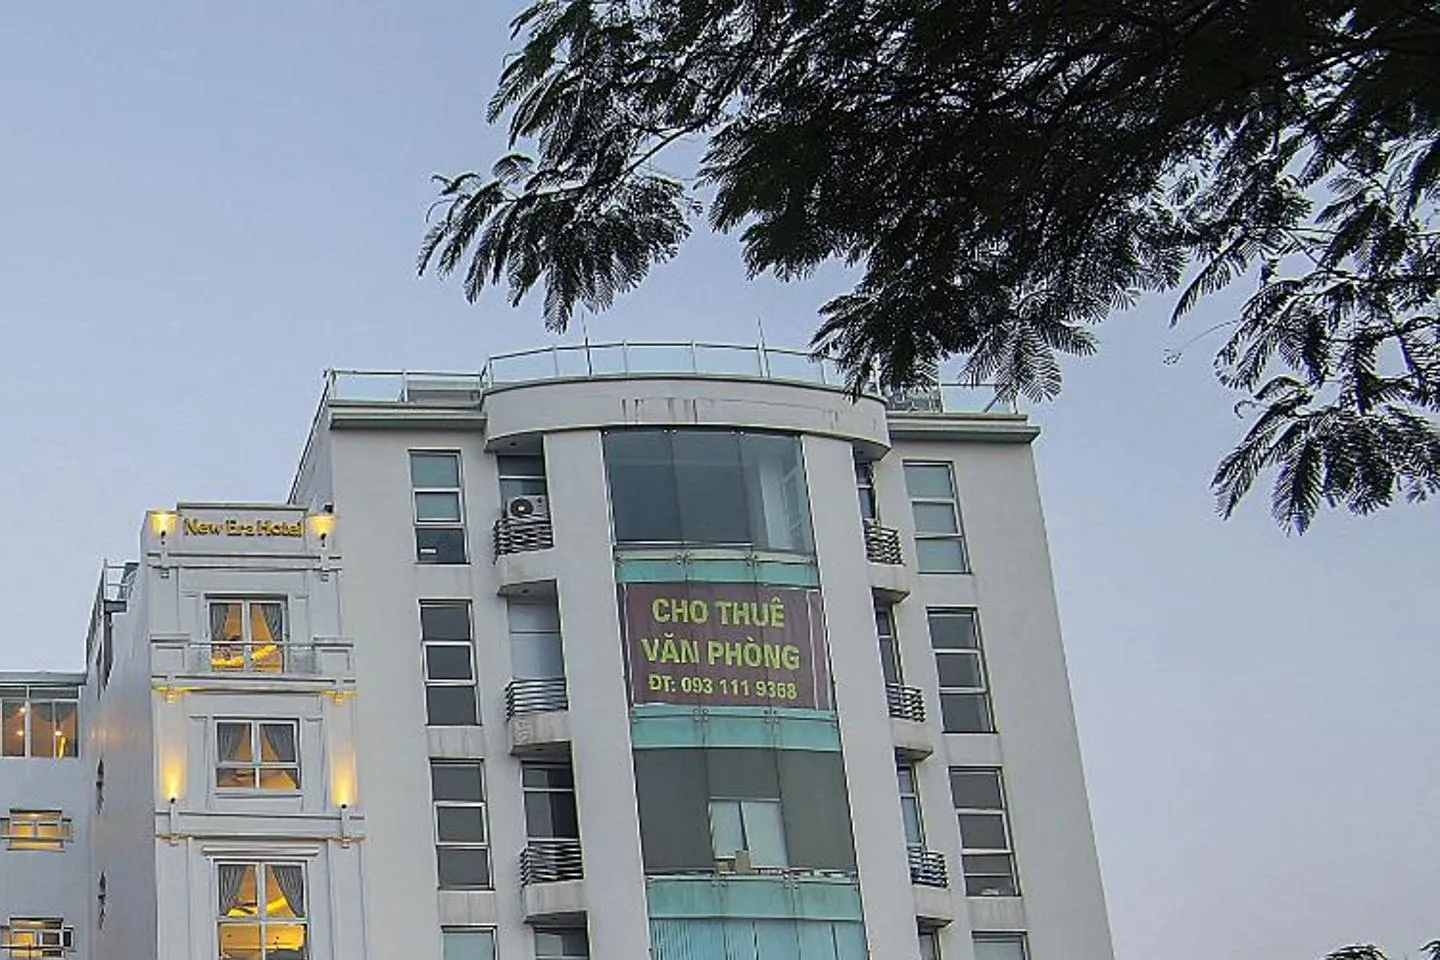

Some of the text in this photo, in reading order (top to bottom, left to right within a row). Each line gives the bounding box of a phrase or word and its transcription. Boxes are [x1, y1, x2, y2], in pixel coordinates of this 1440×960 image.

[651, 596, 786, 628] CHO THUÊ
[641, 632, 800, 669] VĂN PHÒNG
[648, 673, 676, 692] ĐT:
[681, 677, 713, 695] 093
[720, 679, 749, 696] 111
